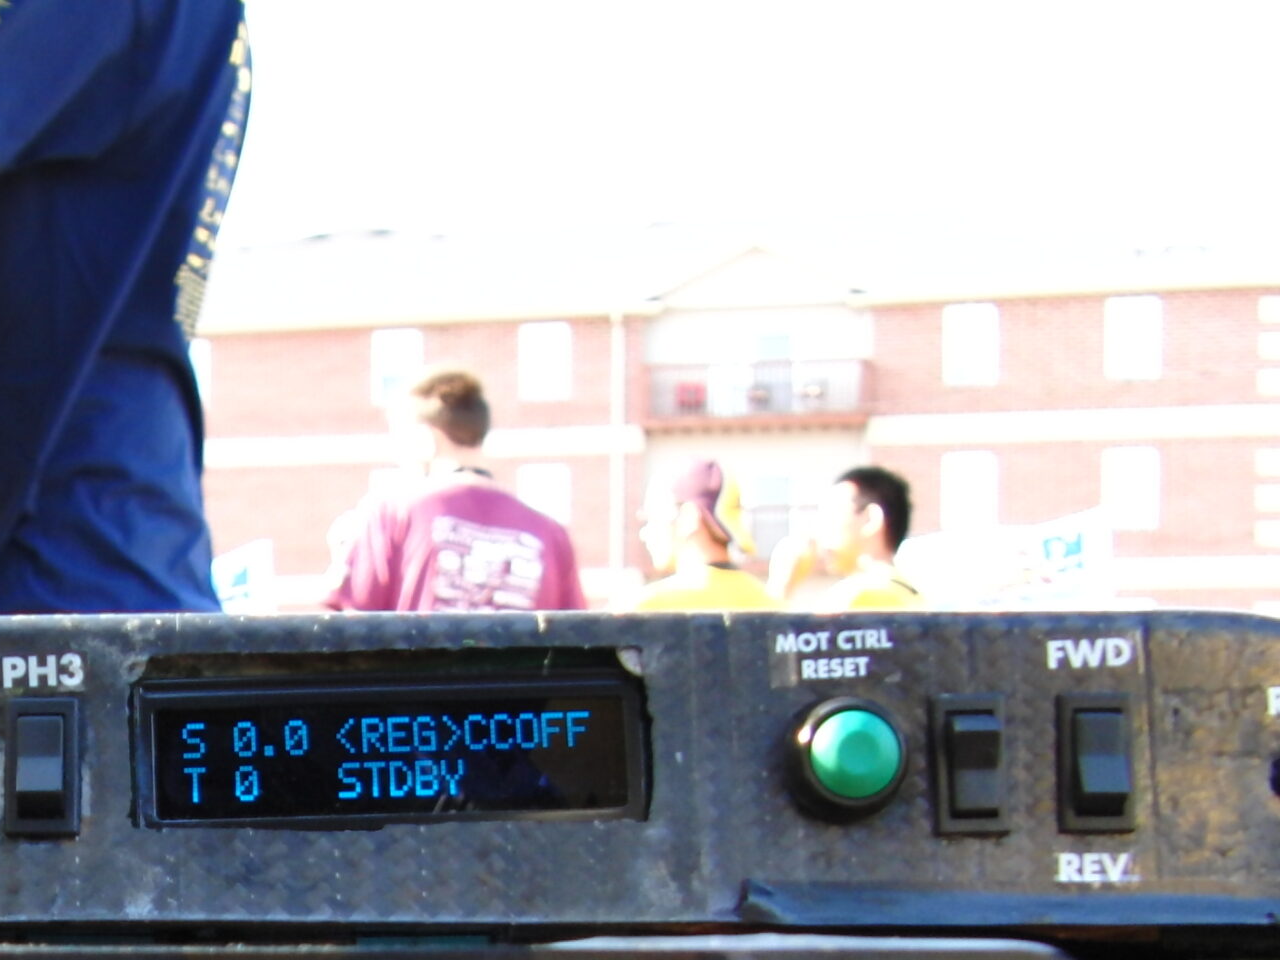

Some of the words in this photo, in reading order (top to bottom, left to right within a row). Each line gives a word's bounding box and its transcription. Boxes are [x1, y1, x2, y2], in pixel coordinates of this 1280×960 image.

[775, 632, 832, 654] MOT
[837, 629, 893, 651] CTRL
[1047, 637, 1132, 670] FWD
[2, 653, 84, 689] PH3
[801, 656, 869, 680] RESET
[182, 722, 206, 759] S
[233, 719, 309, 757] 0.0
[183, 766, 207, 804] T
[234, 764, 261, 803] 0
[338, 758, 465, 799] STDBY
[1056, 851, 1130, 883] REV
